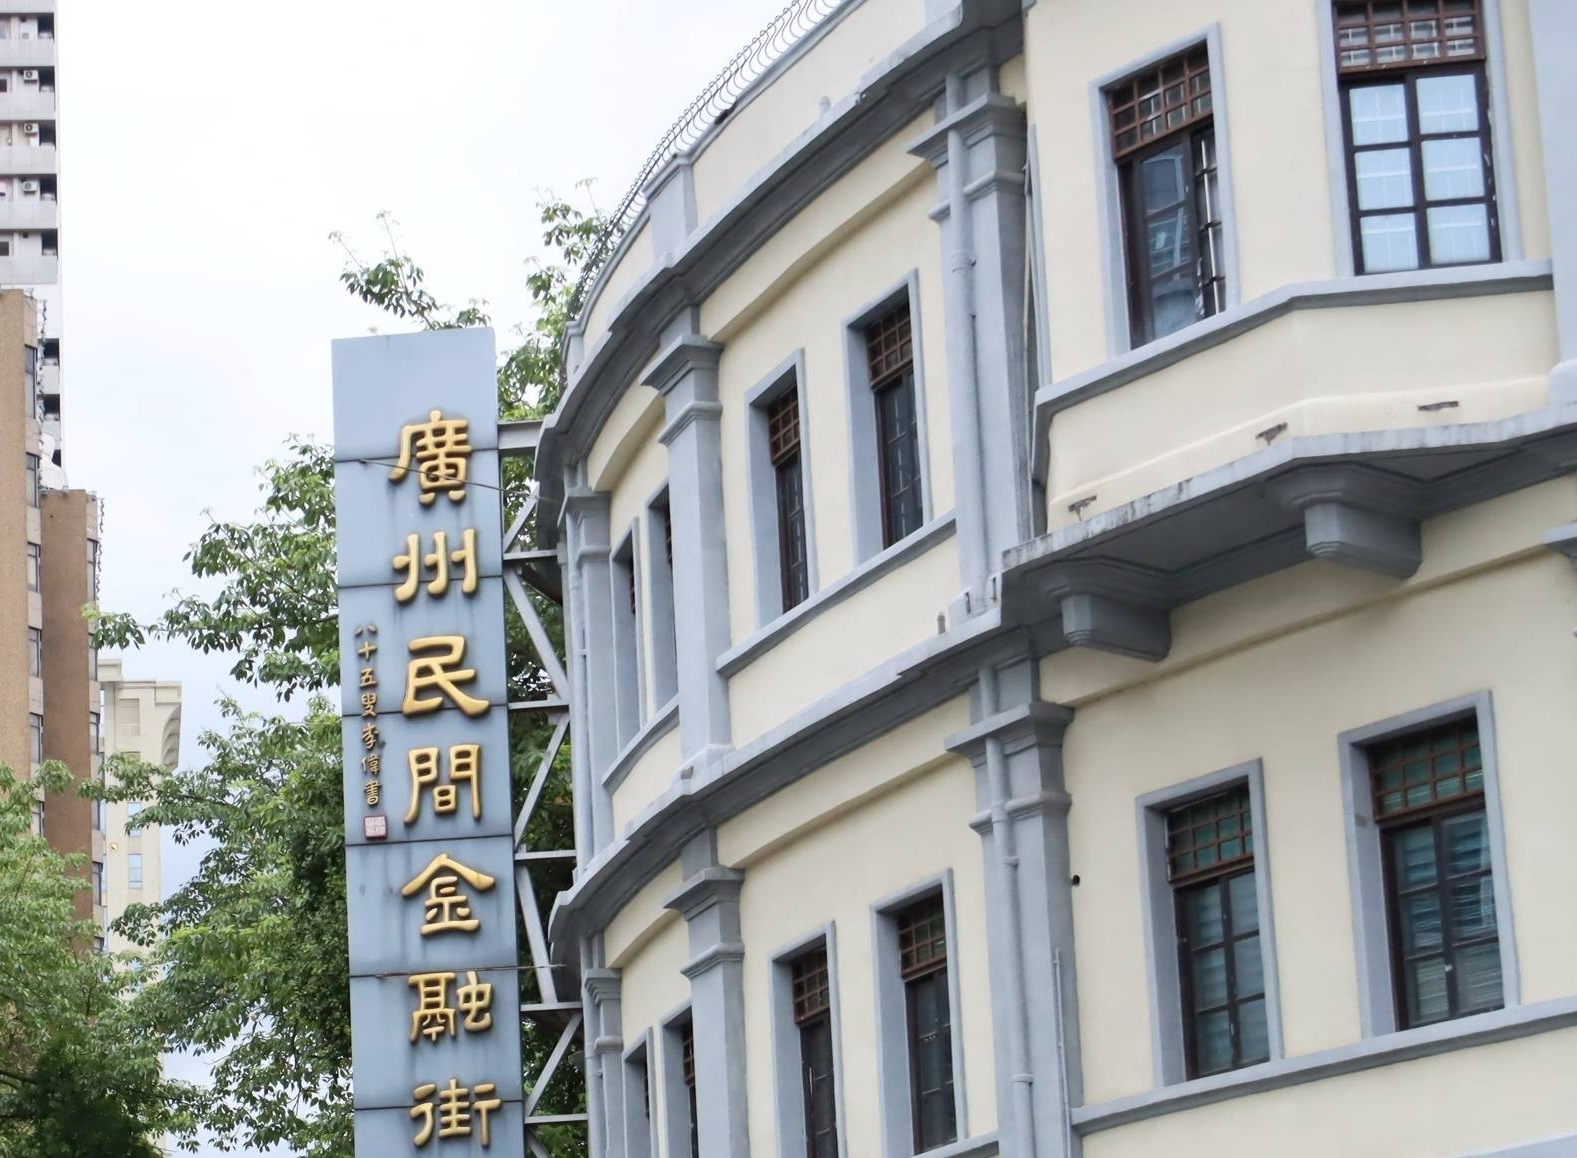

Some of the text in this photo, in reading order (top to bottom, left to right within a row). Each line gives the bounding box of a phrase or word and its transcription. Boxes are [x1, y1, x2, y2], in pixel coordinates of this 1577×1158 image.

[388, 409, 502, 1149] 廣州民間金融街
